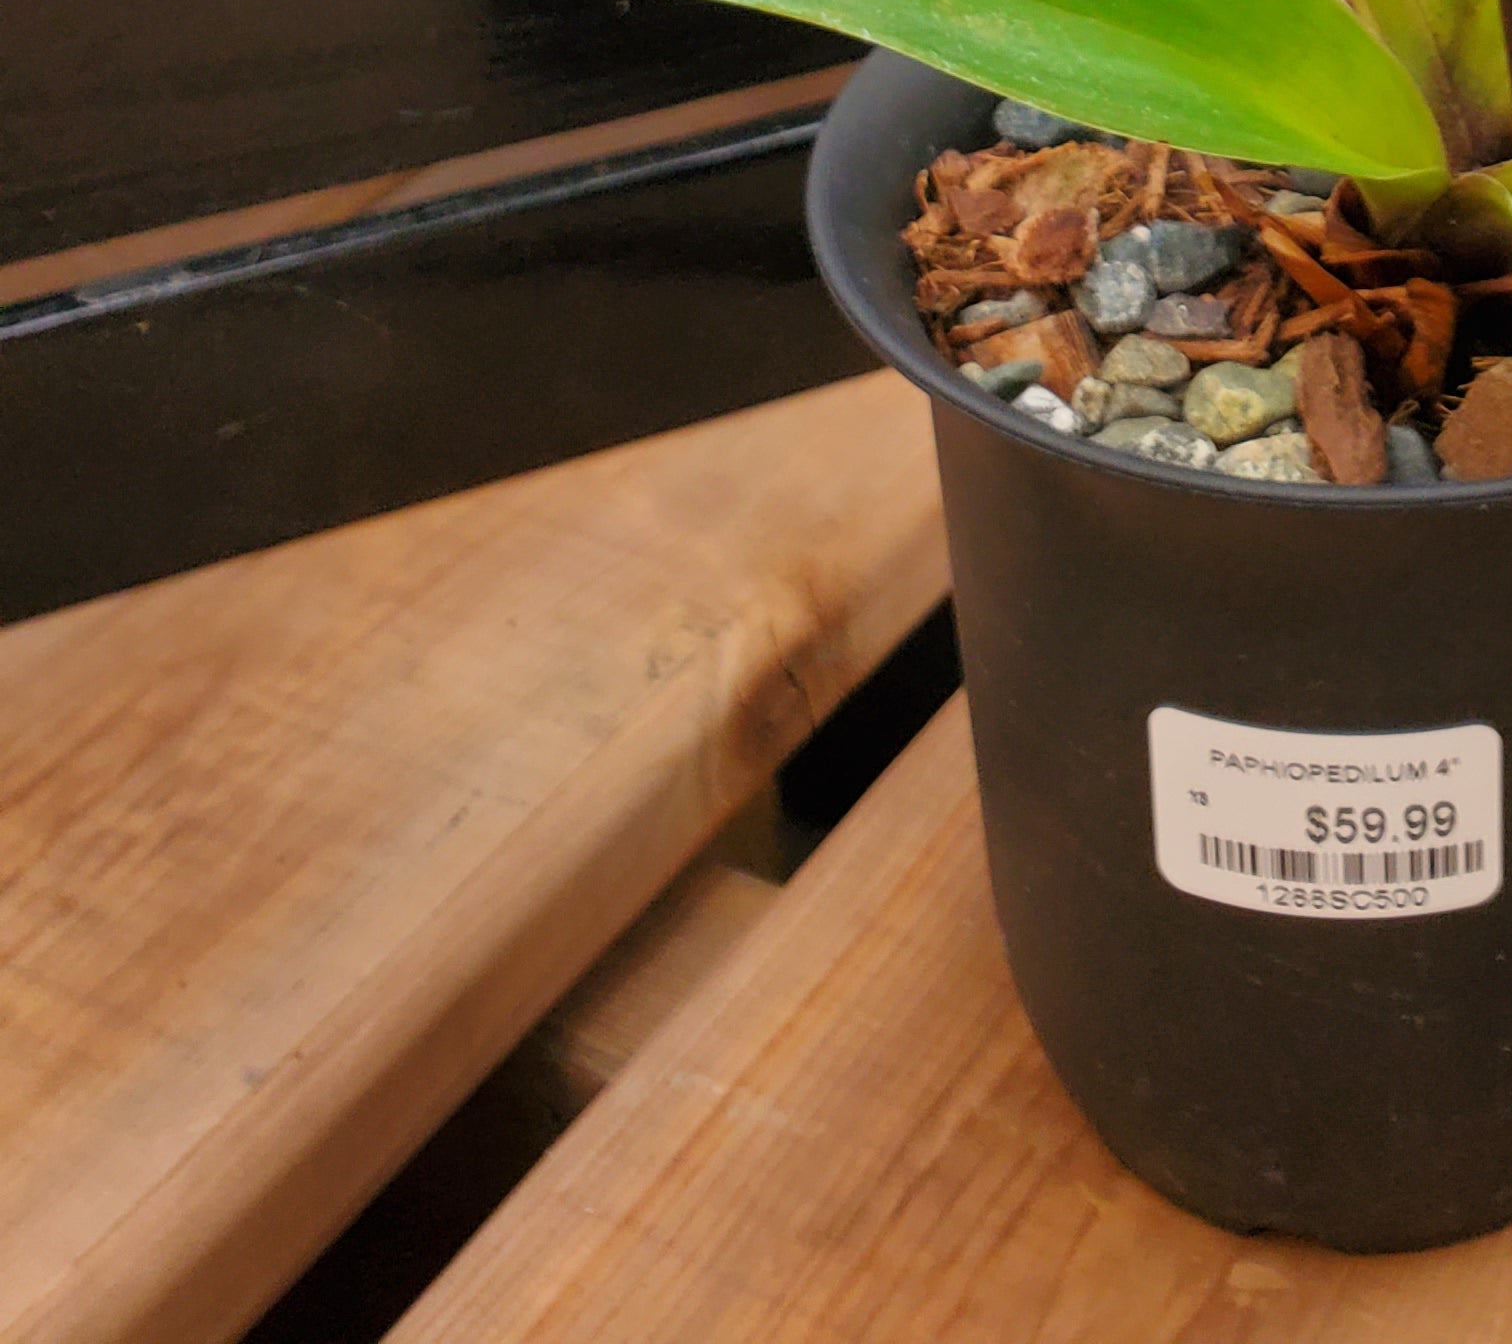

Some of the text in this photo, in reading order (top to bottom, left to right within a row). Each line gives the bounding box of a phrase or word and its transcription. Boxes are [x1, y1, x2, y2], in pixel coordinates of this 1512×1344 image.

[1209, 749, 1427, 784] PAPHIOPEDILUM
[1306, 801, 1457, 844] $59.99
[1256, 883, 1429, 910] 1288SC500
